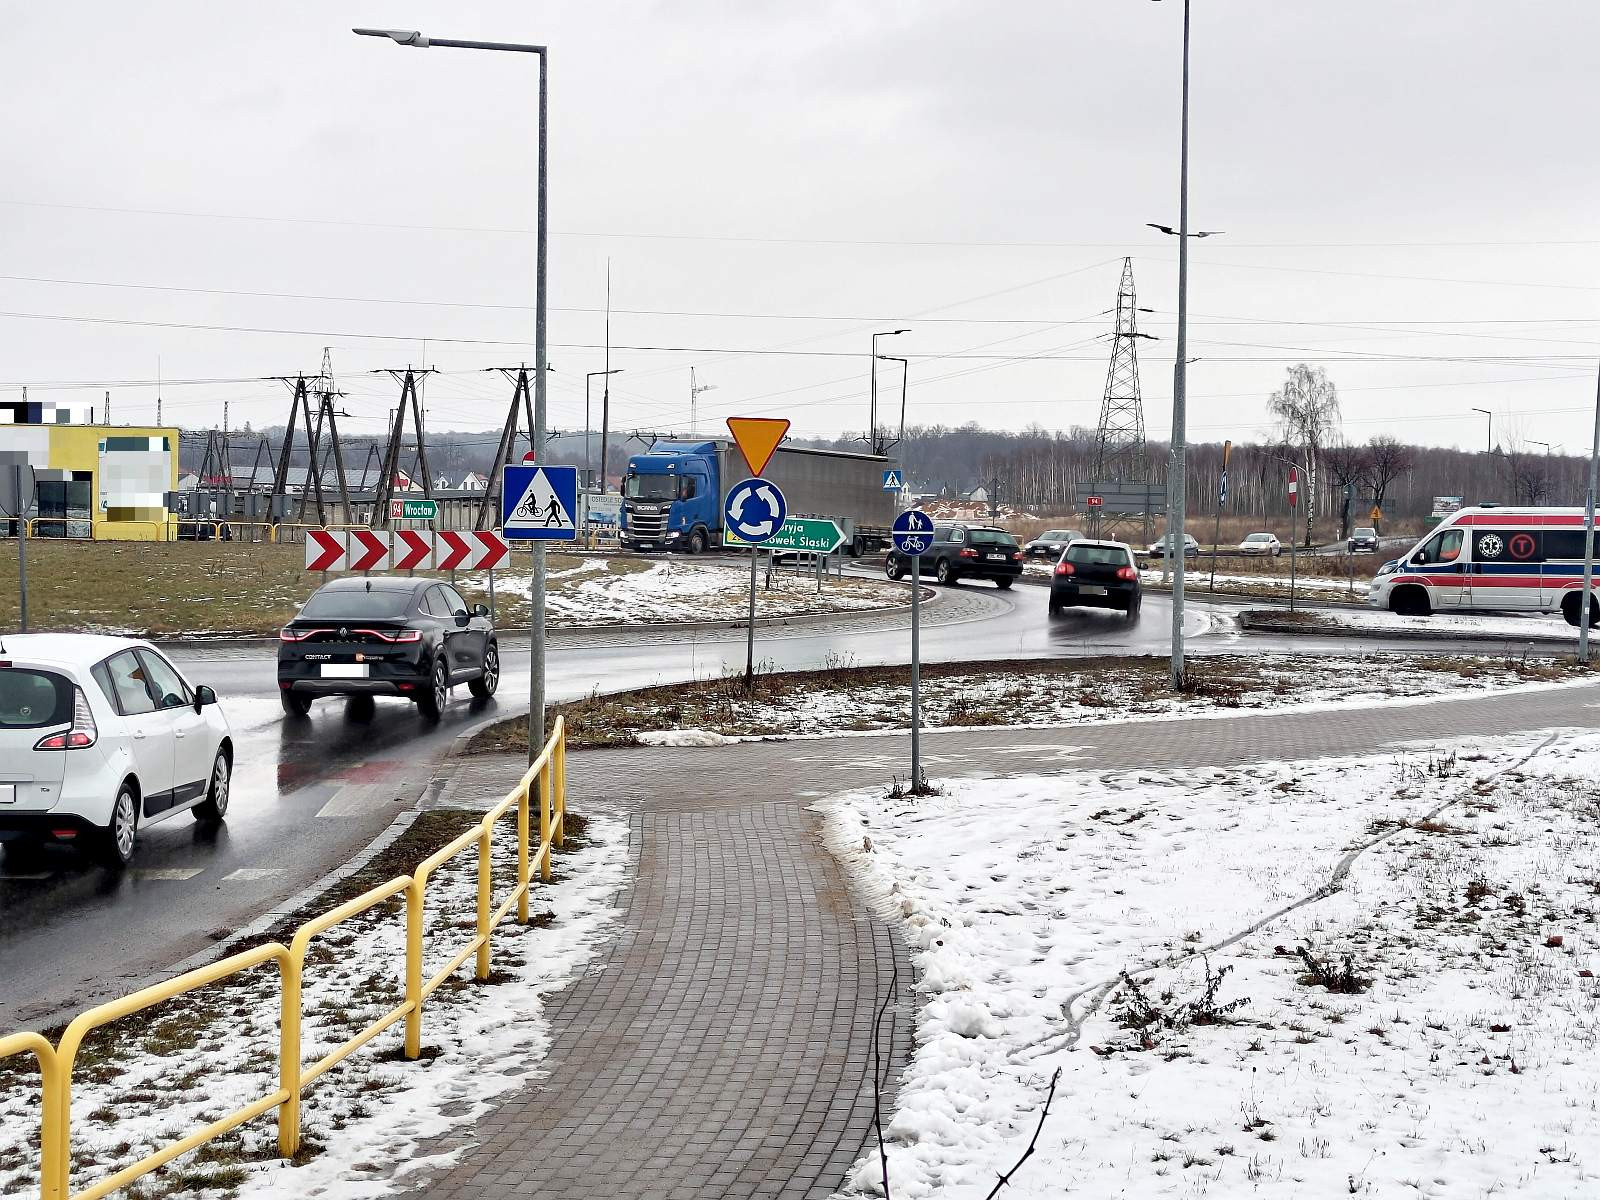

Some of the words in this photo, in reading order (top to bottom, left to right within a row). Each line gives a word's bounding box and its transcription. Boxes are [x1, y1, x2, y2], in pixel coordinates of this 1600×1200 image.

[393, 503, 401, 516] 94
[405, 503, 432, 516] Wrocław
[799, 534, 830, 549] Śląski
